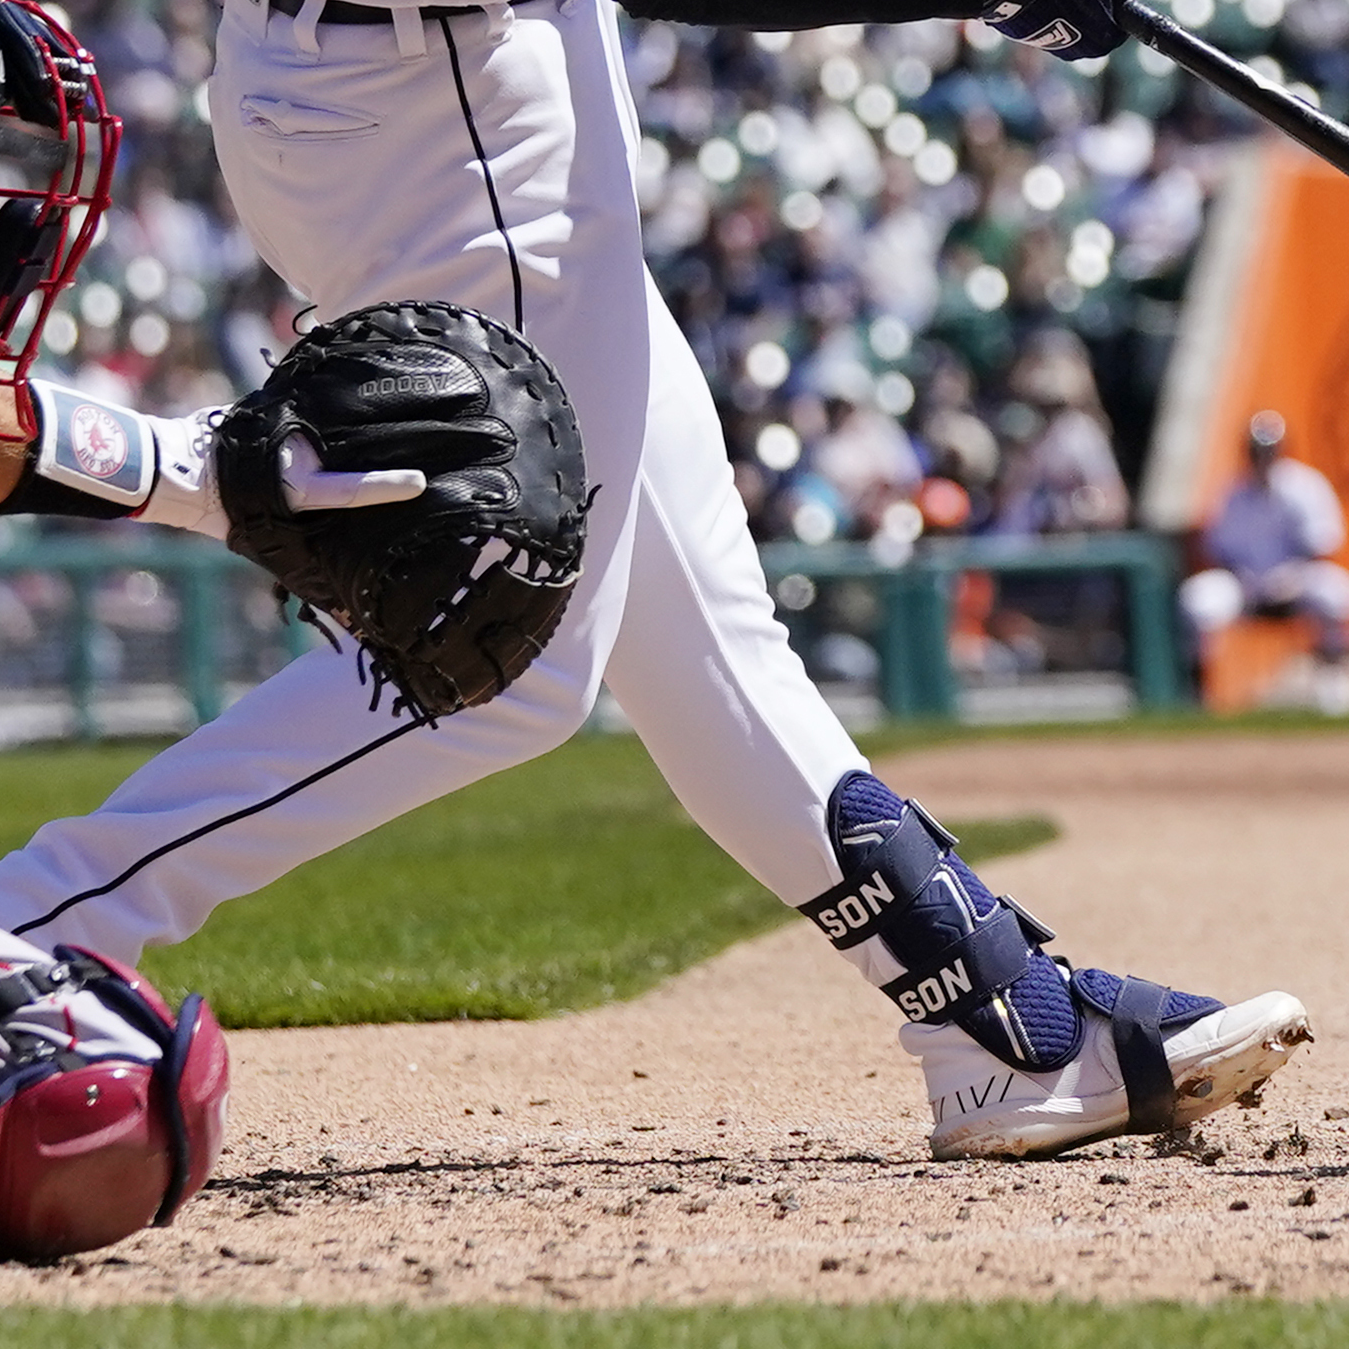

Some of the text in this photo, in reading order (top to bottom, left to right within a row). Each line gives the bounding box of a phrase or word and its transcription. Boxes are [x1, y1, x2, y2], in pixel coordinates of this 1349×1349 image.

[359, 374, 449, 398] A2000
[818, 870, 895, 940] SON
[899, 957, 973, 1022] SON
